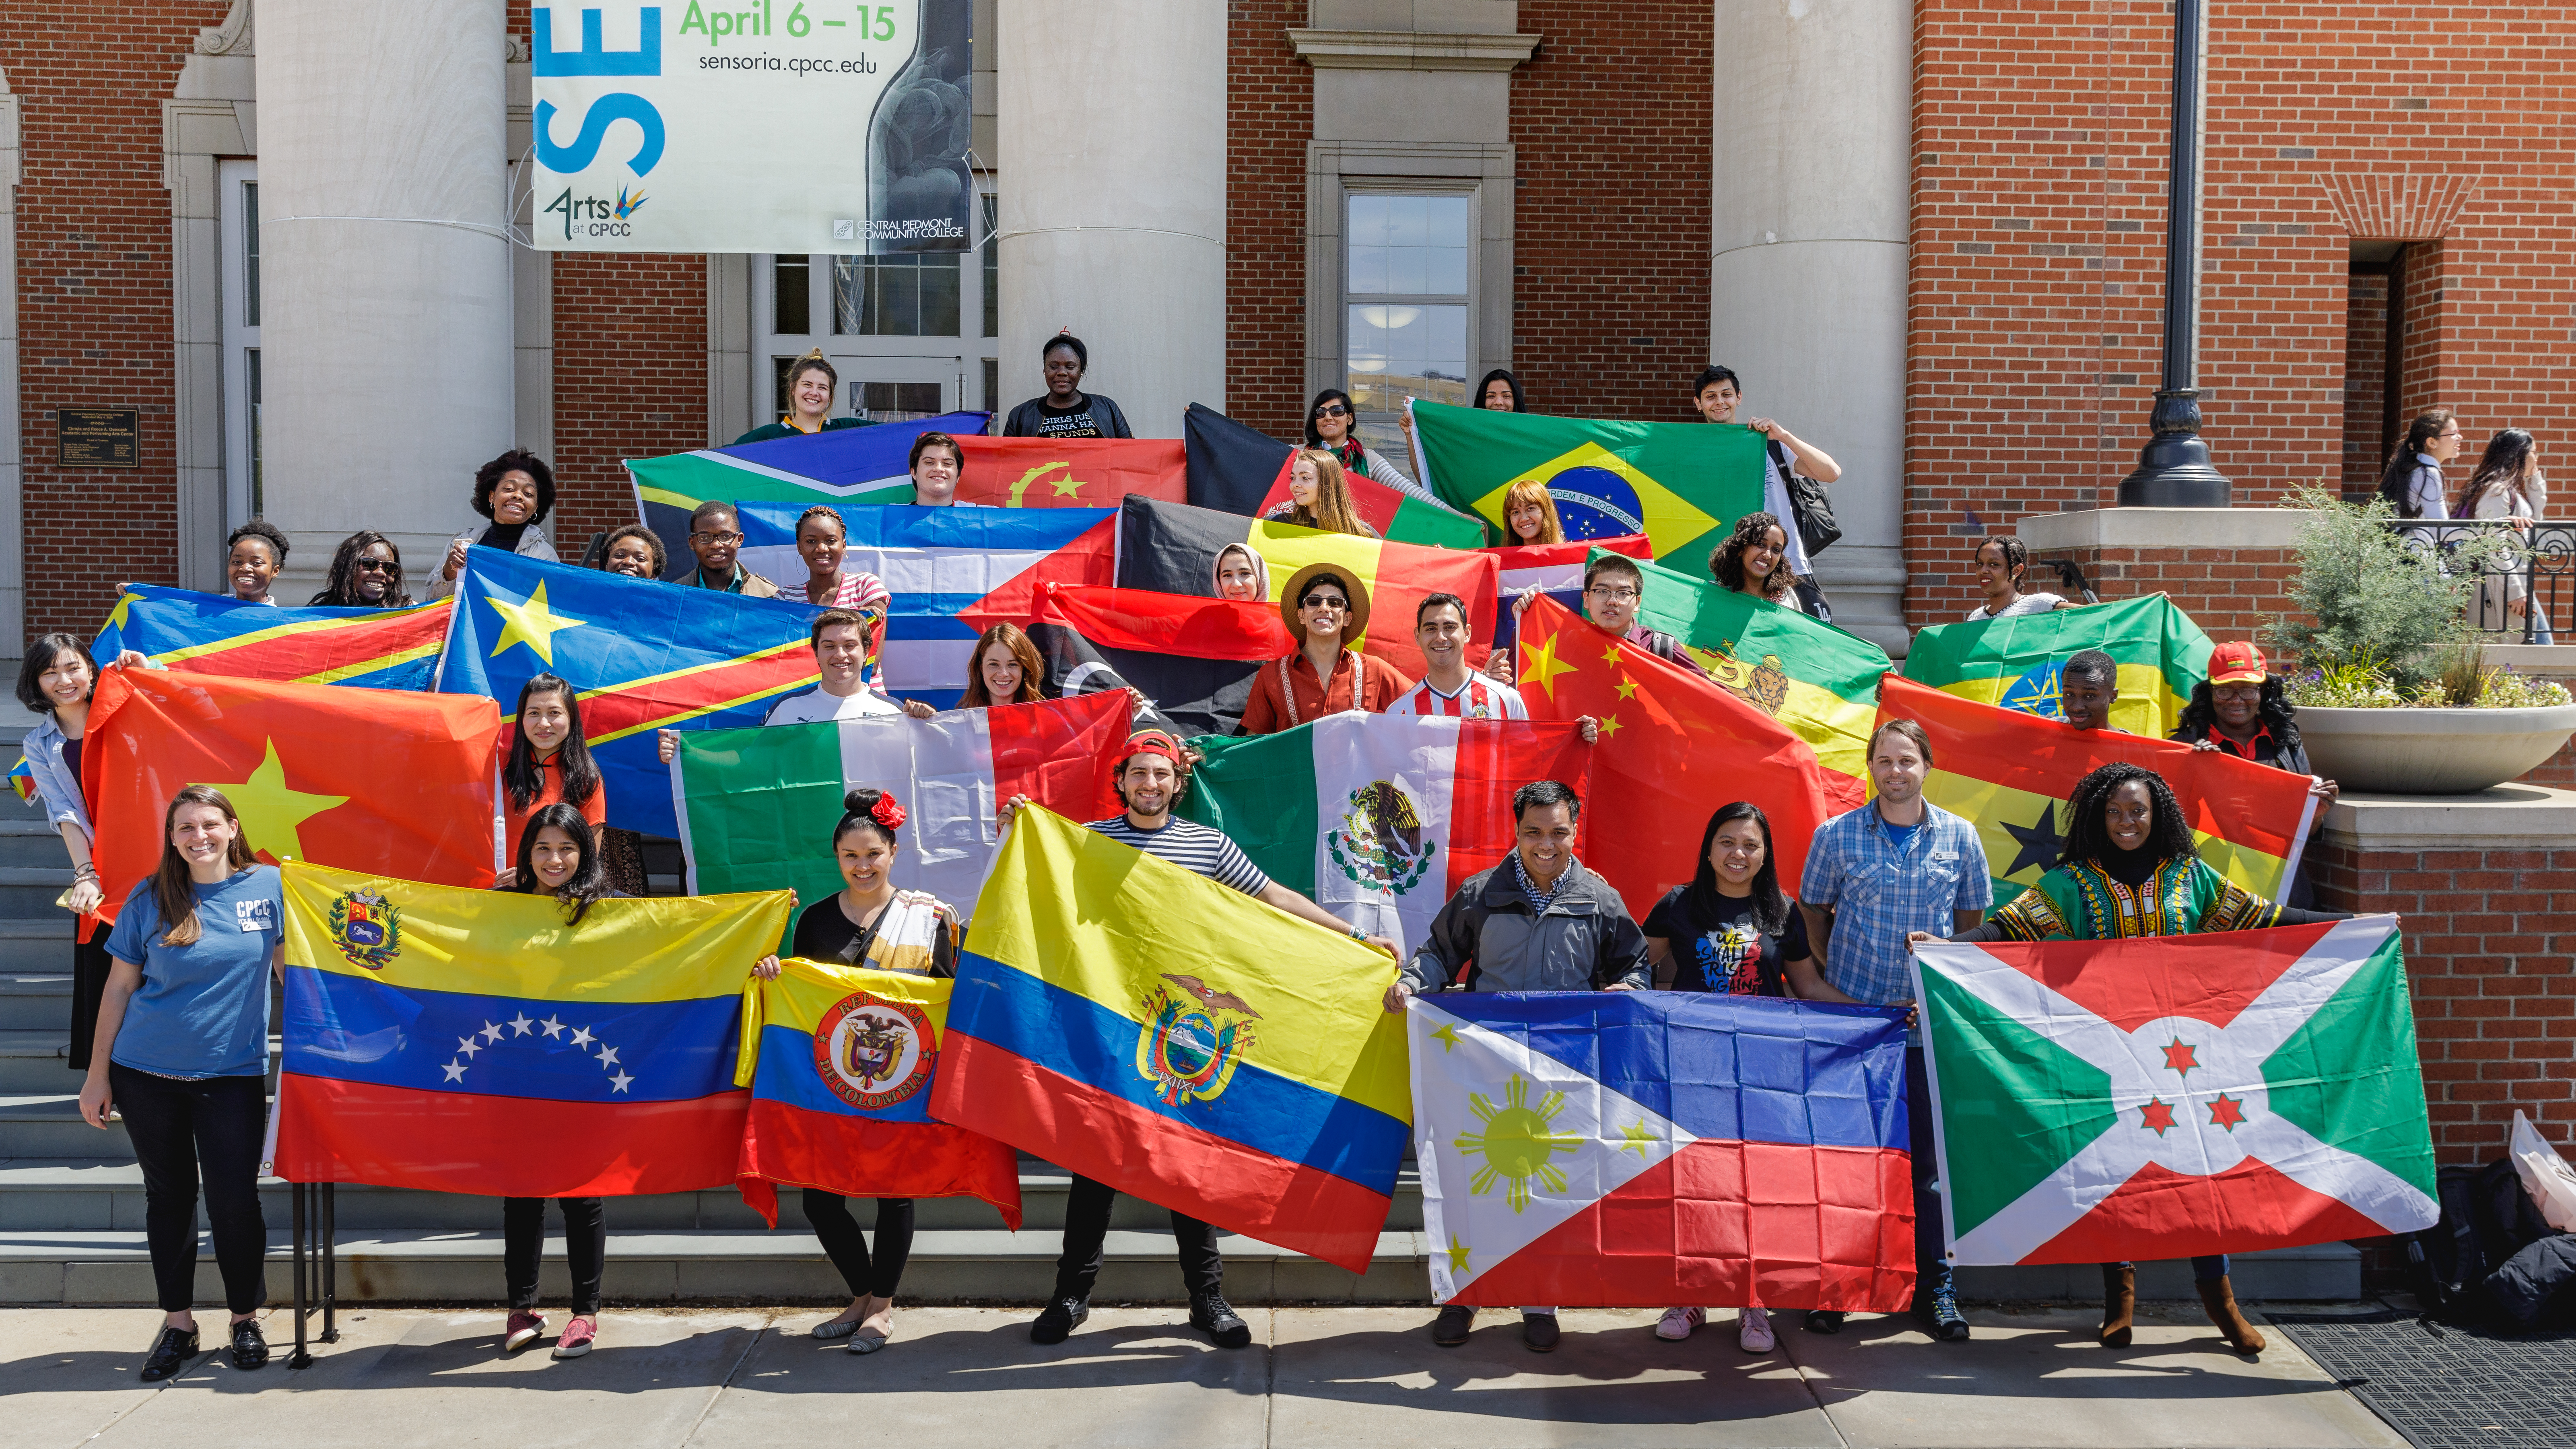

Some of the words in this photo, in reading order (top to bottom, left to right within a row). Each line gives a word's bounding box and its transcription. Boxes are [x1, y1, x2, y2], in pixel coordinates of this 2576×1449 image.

[679, 0, 771, 47] April
[787, 2, 811, 37] 6
[856, 5, 896, 41] 15
[699, 51, 877, 77] sensoria.cpcc.edu
[543, 185, 610, 241] Arts
[573, 224, 585, 235] at
[589, 223, 631, 237] CPCC
[857, 220, 901, 230] CENTRAL
[902, 218, 952, 230] PIEDMONT
[857, 229, 919, 239] COMMUNITY
[921, 227, 964, 238] COLLEGE
[1043, 416, 1072, 425] GIRLS
[1050, 429, 1096, 439] $FUND$
[1587, 497, 1640, 530] PROGRESSO
[236, 899, 270, 918] CPCC
[1716, 933, 1759, 945] WE
[1700, 945, 1755, 962] SHALL
[1700, 961, 1750, 977] RISE
[1710, 978, 1752, 992] AGAIN
[819, 1058, 839, 1084] DE
[835, 1072, 925, 1107] COLOMBIA
